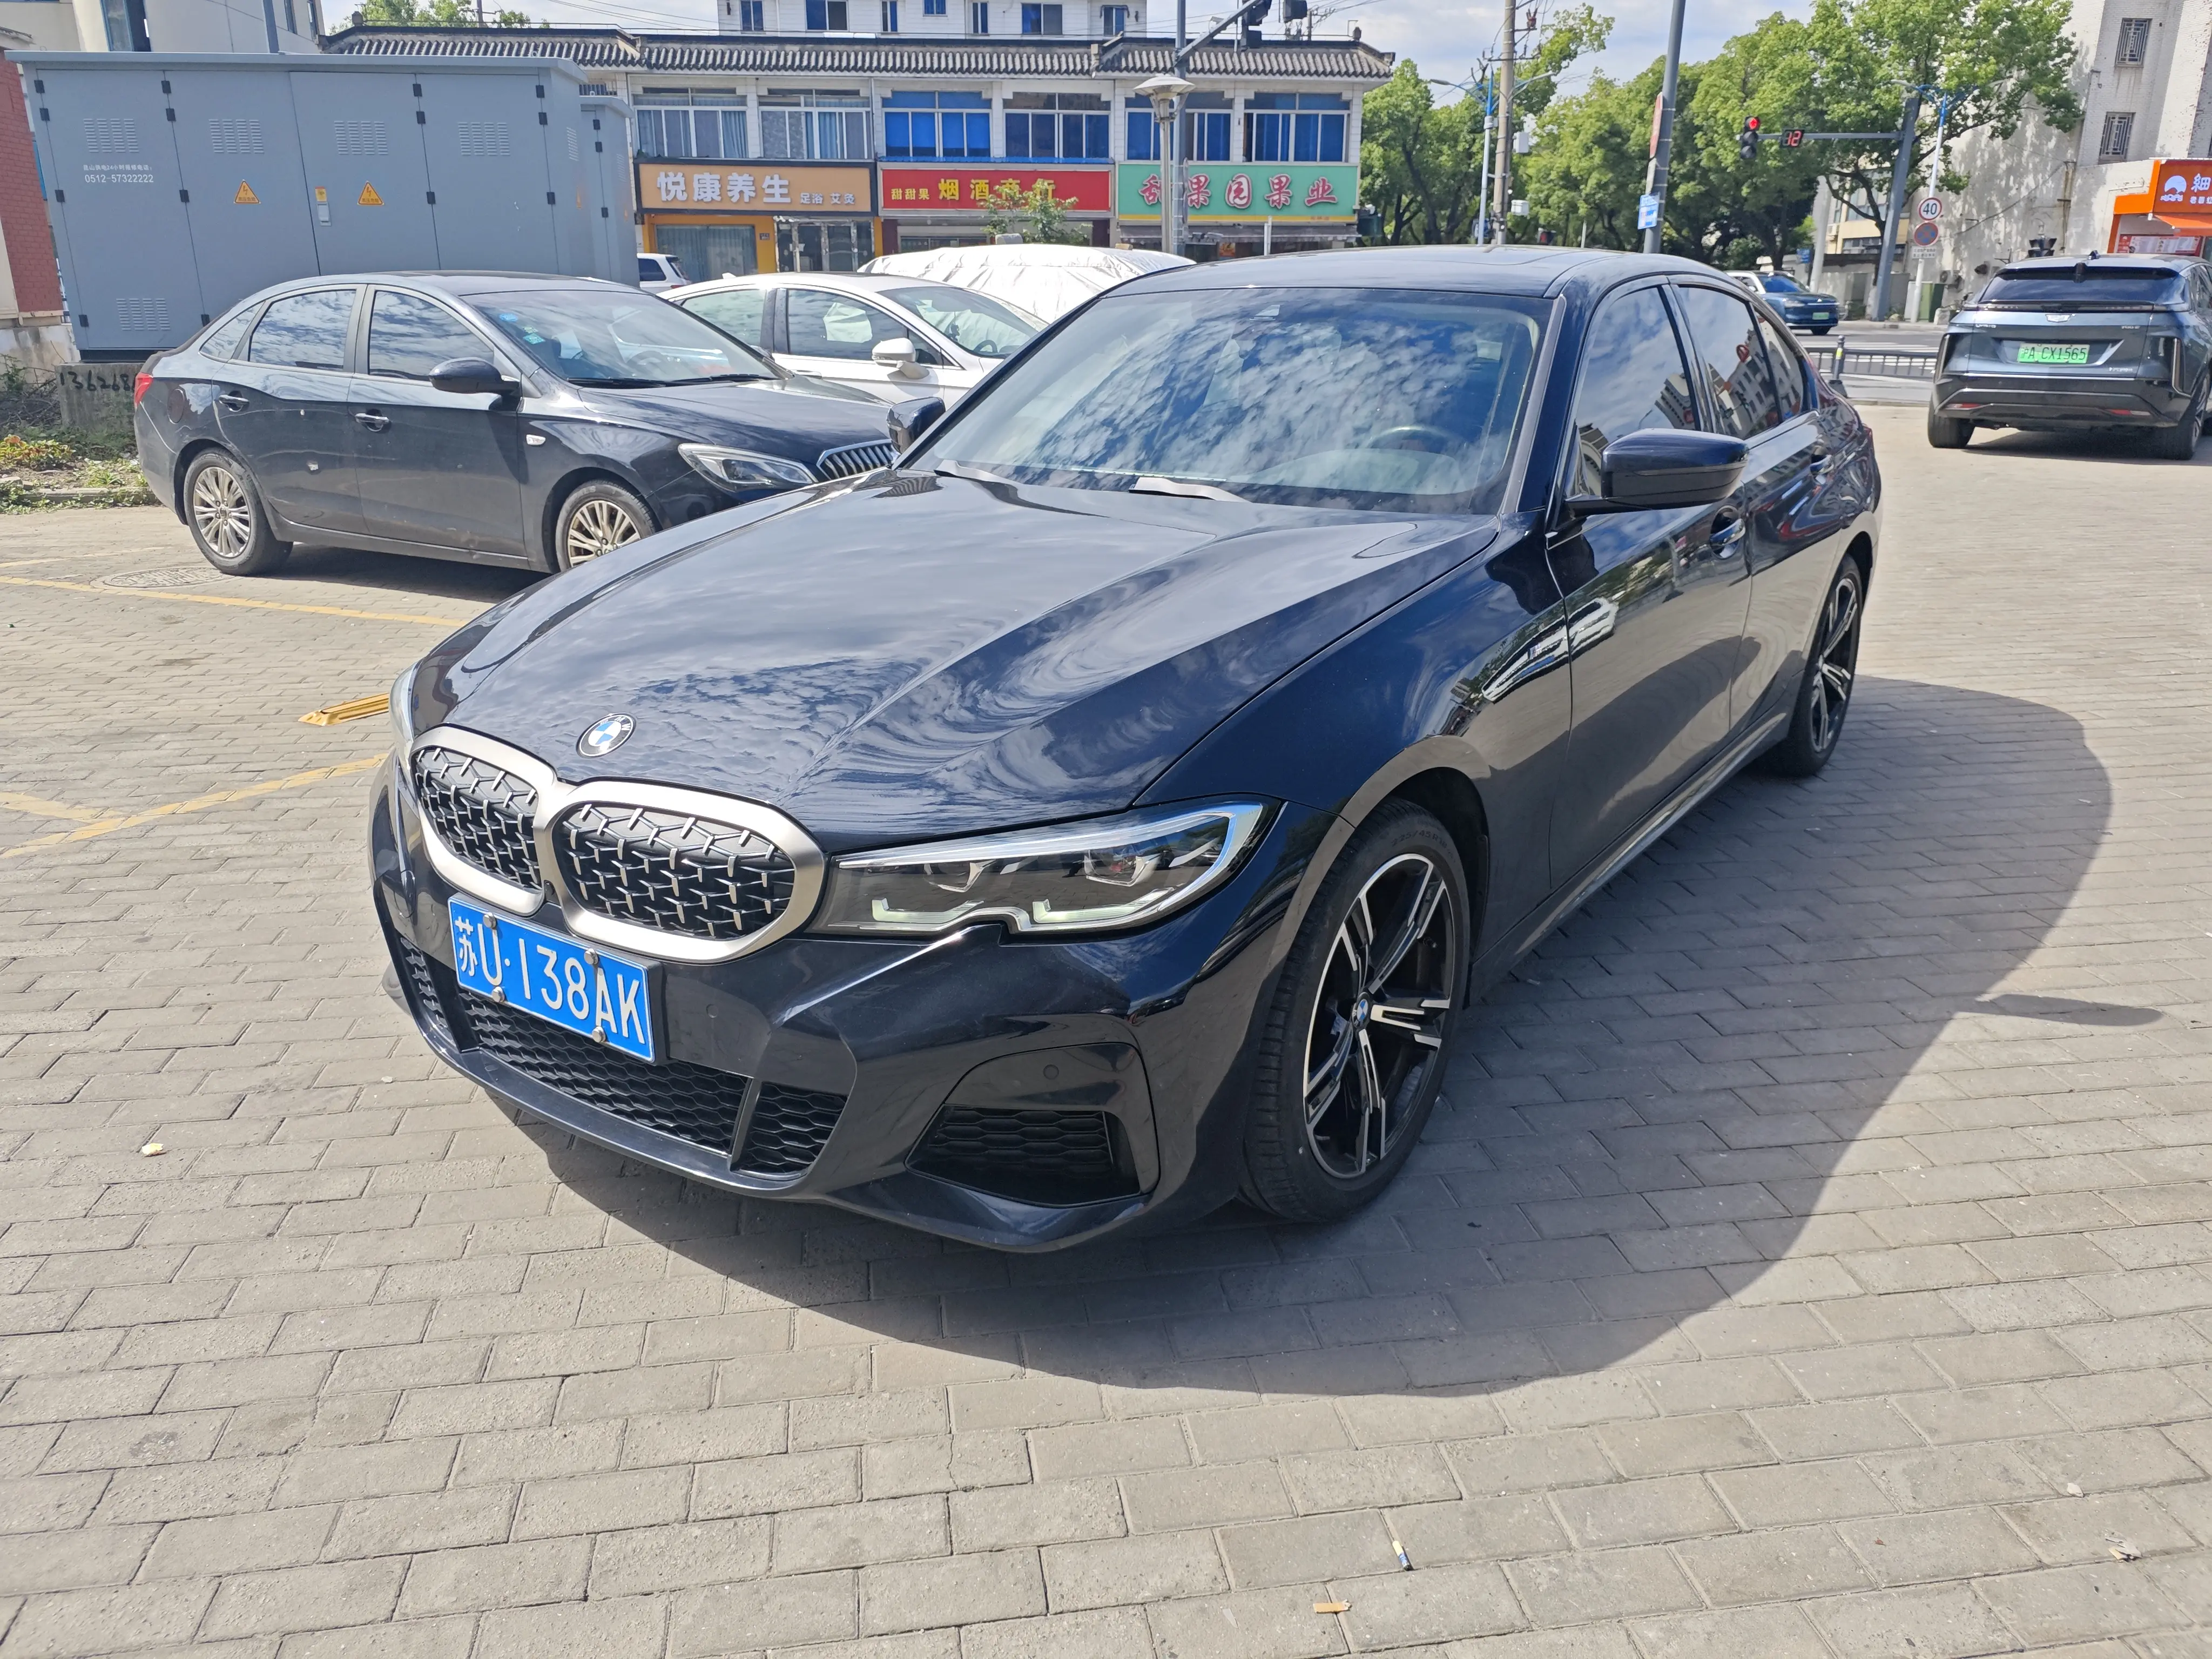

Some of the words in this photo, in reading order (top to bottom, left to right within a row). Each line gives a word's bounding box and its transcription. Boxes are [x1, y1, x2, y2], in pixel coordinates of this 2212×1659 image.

[85, 174, 154, 183] 0512-57322222
[657, 171, 791, 203] 悦康养生
[800, 192, 823, 204] 足浴
[891, 188, 930, 200] 甜甜果
[1923, 203, 1938, 215] 40
[2041, 347, 2087, 360] CX1565
